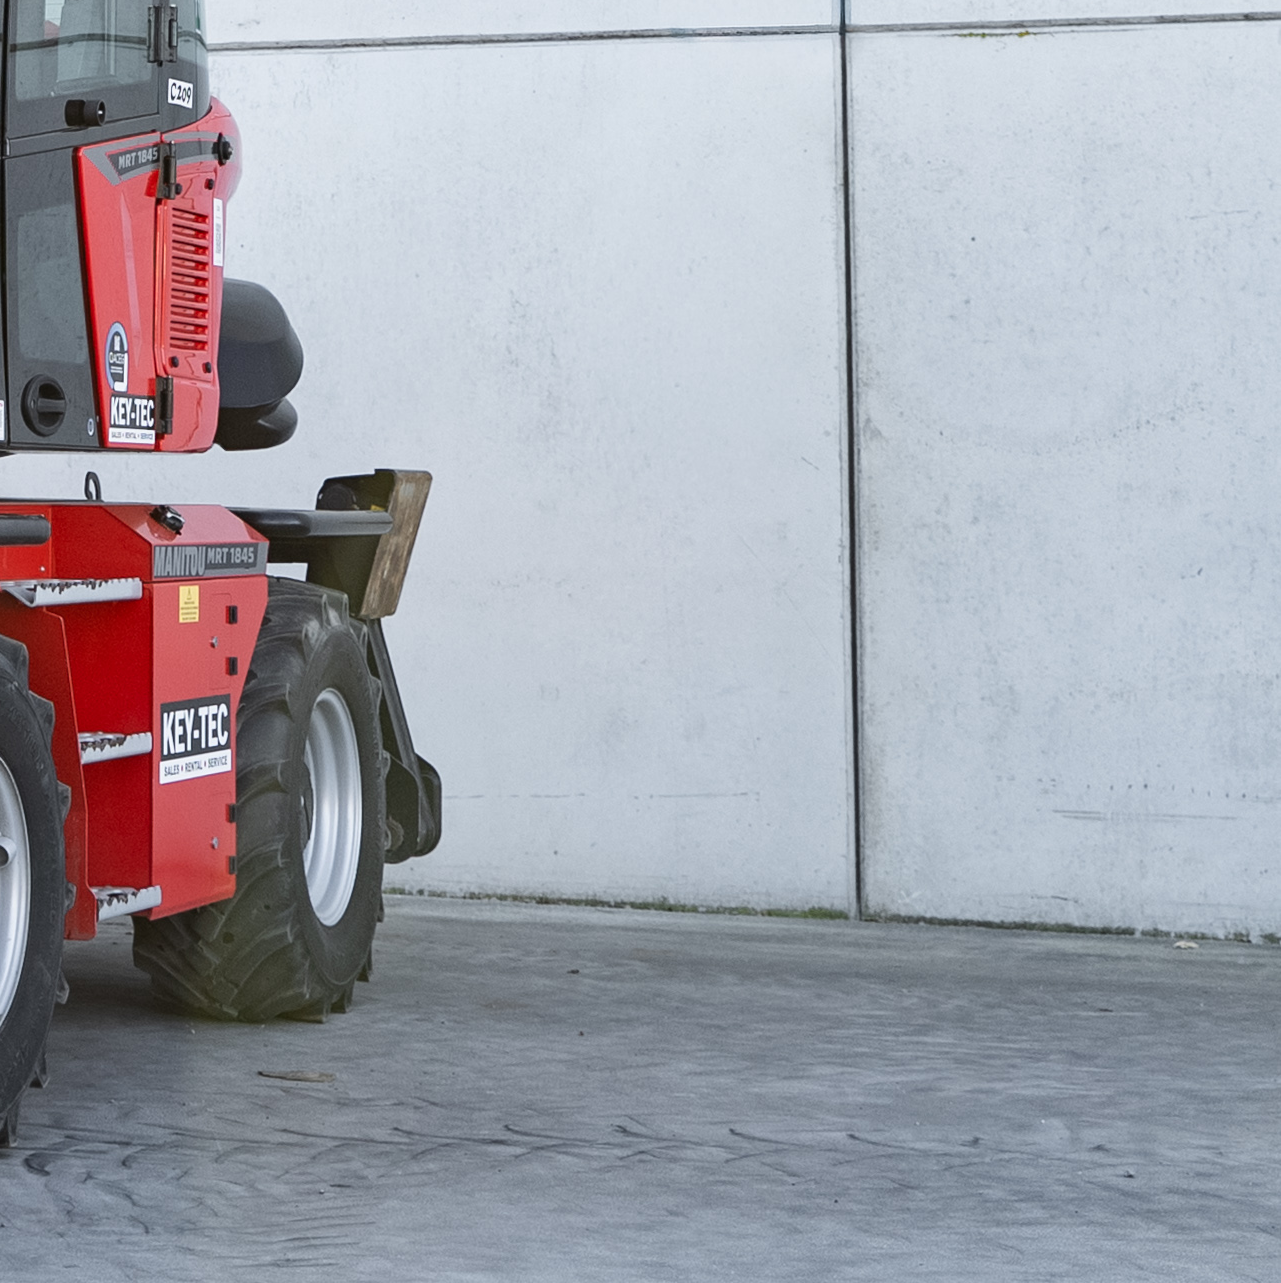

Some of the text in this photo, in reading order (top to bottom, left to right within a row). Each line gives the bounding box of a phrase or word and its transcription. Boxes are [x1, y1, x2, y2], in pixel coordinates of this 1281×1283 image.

[170, 82, 192, 105] C209
[118, 146, 158, 170] MRT 1845
[110, 396, 155, 428] KEY-TEC
[154, 546, 255, 576] MANITOU MRT 1845
[163, 702, 229, 756] KEY-TEC
